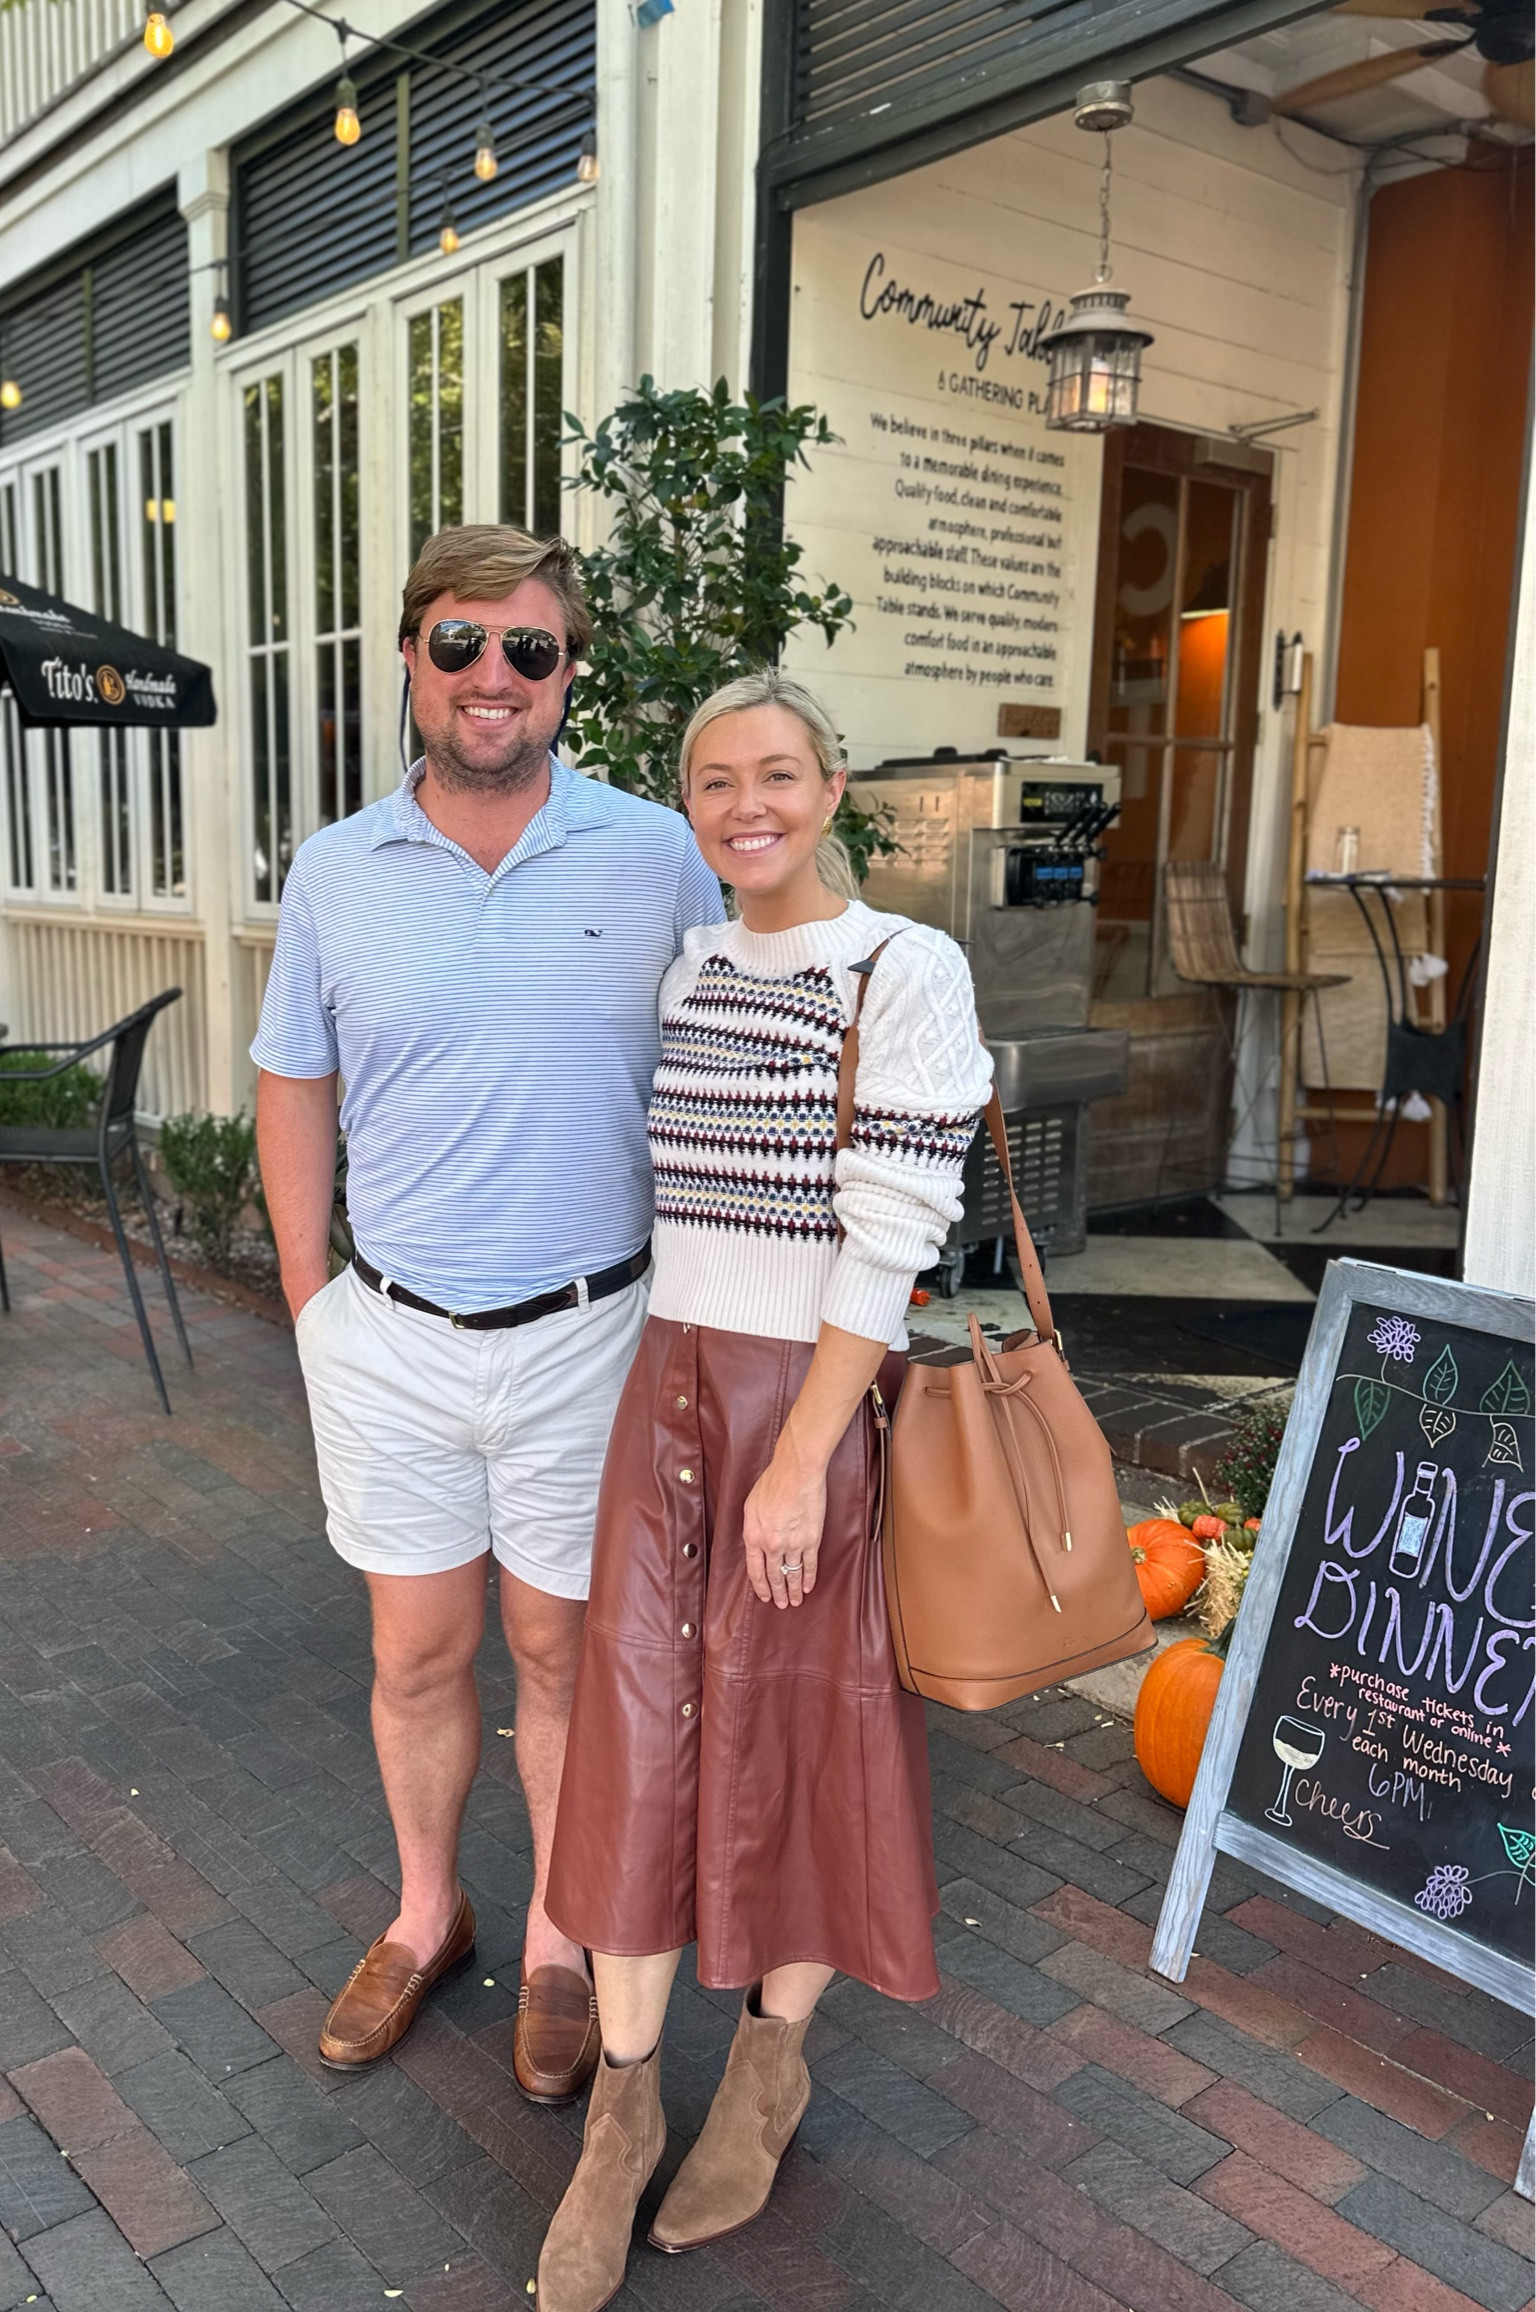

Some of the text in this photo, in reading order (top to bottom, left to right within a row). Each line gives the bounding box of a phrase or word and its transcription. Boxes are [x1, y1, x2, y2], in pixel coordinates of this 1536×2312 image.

[861, 253, 1001, 371] Community
[950, 373, 1023, 409] GATHERING
[870, 412, 888, 431] We
[890, 414, 927, 439] believe
[930, 426, 939, 441] in
[942, 428, 967, 447] three
[970, 435, 998, 455] pillars
[1001, 441, 1025, 460] when
[1036, 451, 1064, 467] comes
[901, 451, 911, 467] to
[914, 456, 919, 469] a
[923, 457, 978, 481] memorable
[981, 464, 1011, 491] dining
[895, 479, 932, 506] Quality
[961, 490, 986, 509] clean
[989, 497, 1007, 513] and
[1009, 501, 1062, 522] comfortable
[872, 536, 943, 561] approachable
[971, 548, 997, 569] These
[1001, 554, 1028, 573] values
[1031, 562, 1044, 575] are
[1047, 561, 1061, 578] the
[990, 526, 1044, 547] professional
[1047, 532, 1062, 549] but
[884, 565, 1059, 610] building blocks on which Community
[877, 595, 904, 616] Table
[944, 604, 958, 622] We
[961, 609, 985, 626] serve
[1023, 614, 1058, 634] modern
[904, 629, 1056, 661] comfort food in an approachable
[905, 660, 963, 682] atmosphere
[966, 663, 977, 685] by
[979, 668, 1011, 687] people
[1014, 668, 1033, 685] who
[133, 693, 175, 709] VODKA
[1358, 1687, 1426, 1722] restaurant
[1430, 1716, 1445, 1729] or
[1422, 1697, 1475, 1728] tickets
[1485, 1721, 1504, 1739] in
[1296, 1675, 1514, 1798] Every 1st Wednesday
[1352, 1735, 1462, 1792] each month
